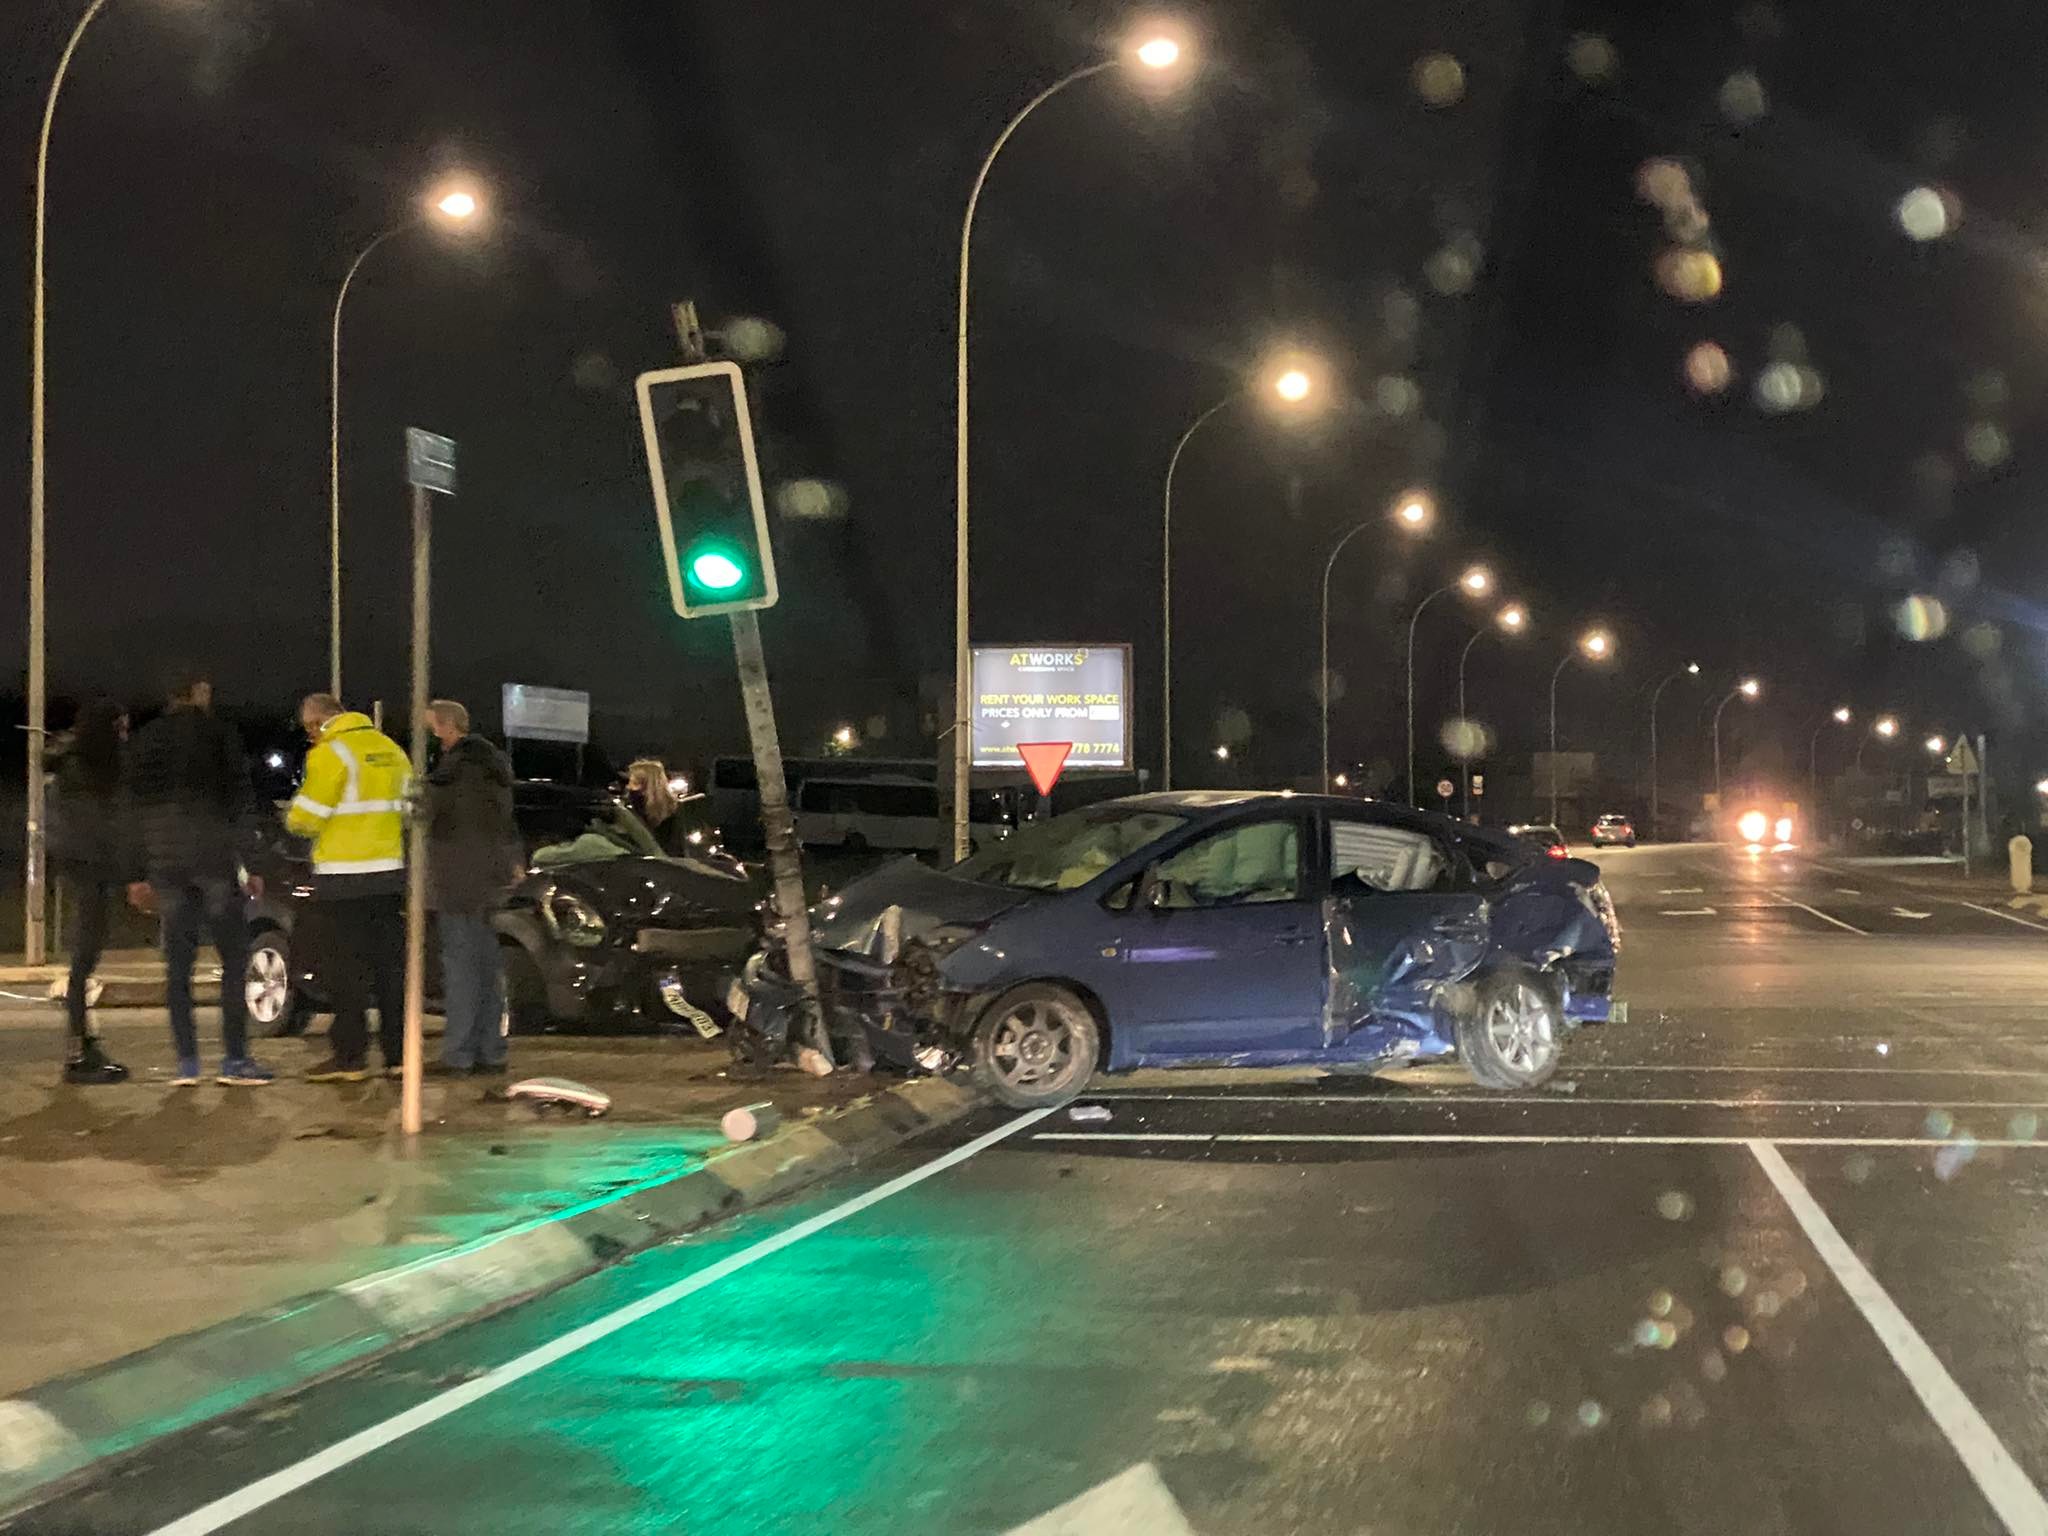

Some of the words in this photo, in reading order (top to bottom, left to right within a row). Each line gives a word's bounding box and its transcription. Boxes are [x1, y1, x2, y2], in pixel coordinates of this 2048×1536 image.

[1010, 653, 1083, 665] ATWORKS
[980, 694, 1010, 704] RENT
[1012, 694, 1044, 704] YOUR
[1046, 694, 1081, 704] WORK
[1084, 694, 1119, 704] SPACE
[982, 707, 1019, 718] PRICES
[1022, 707, 1052, 718] ONLY
[1055, 707, 1088, 718] FROM
